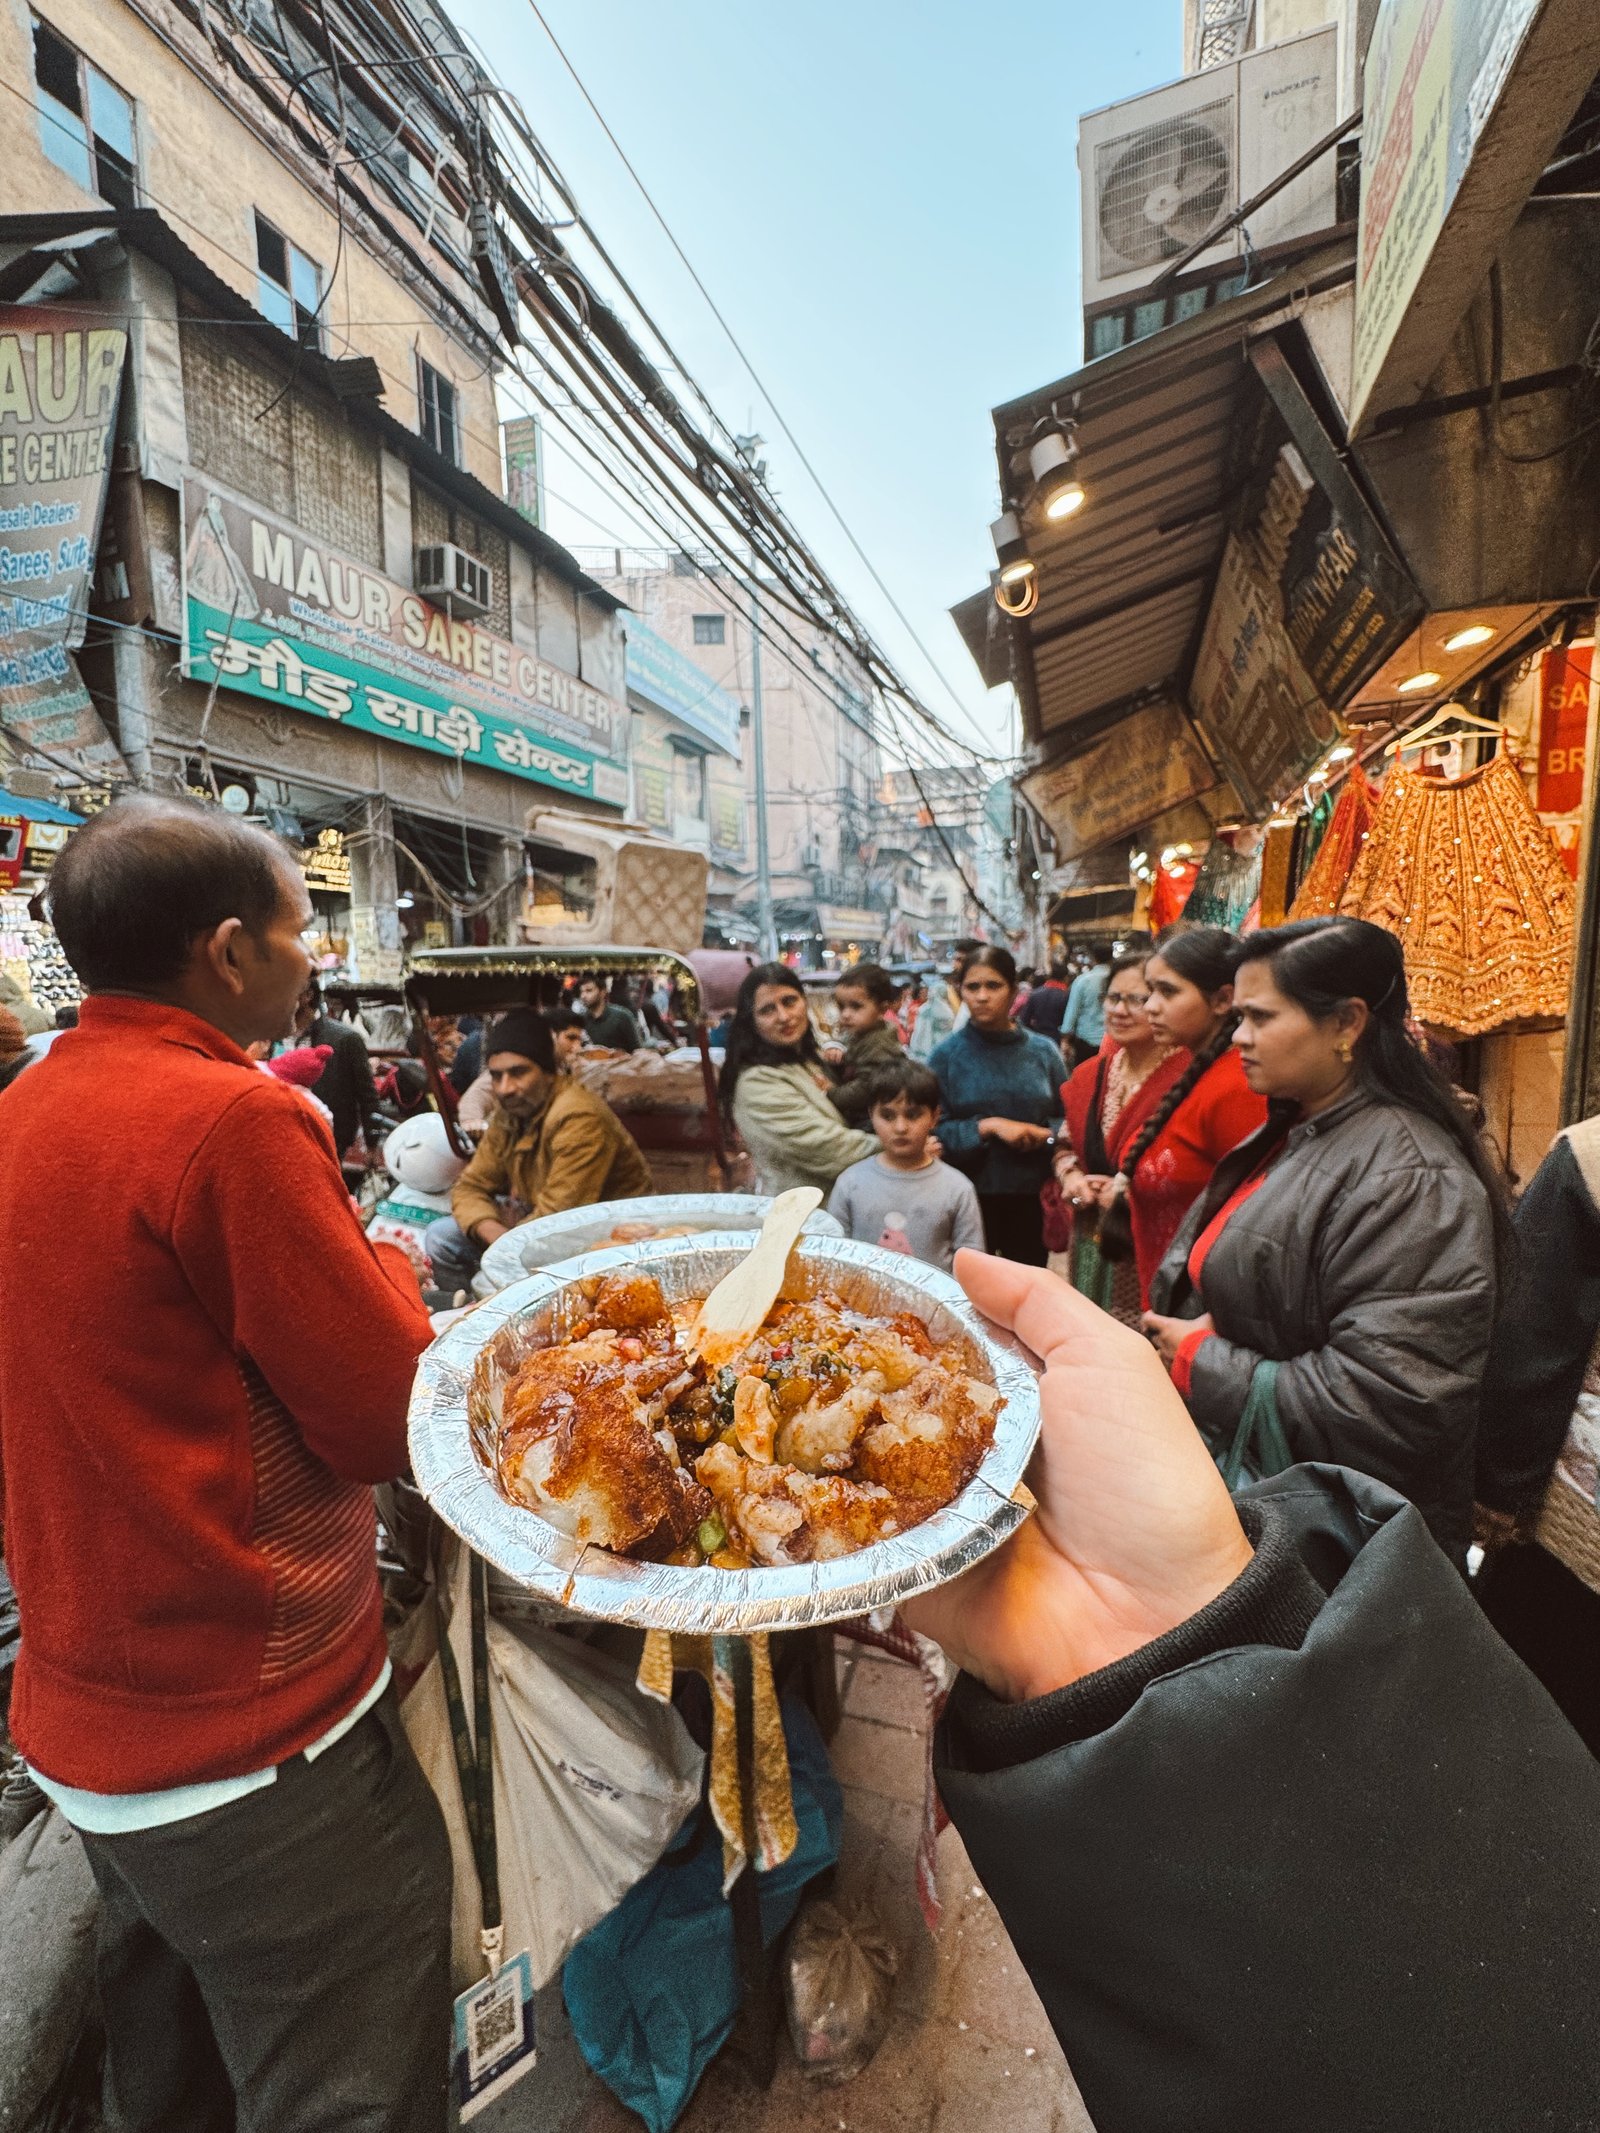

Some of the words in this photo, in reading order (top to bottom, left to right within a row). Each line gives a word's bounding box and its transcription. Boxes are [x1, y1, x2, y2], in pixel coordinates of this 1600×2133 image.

[251, 518, 393, 637] MAUR
[400, 596, 511, 690] SAREE
[516, 653, 611, 734] CENTER
[1312, 527, 1358, 607] WEAR
